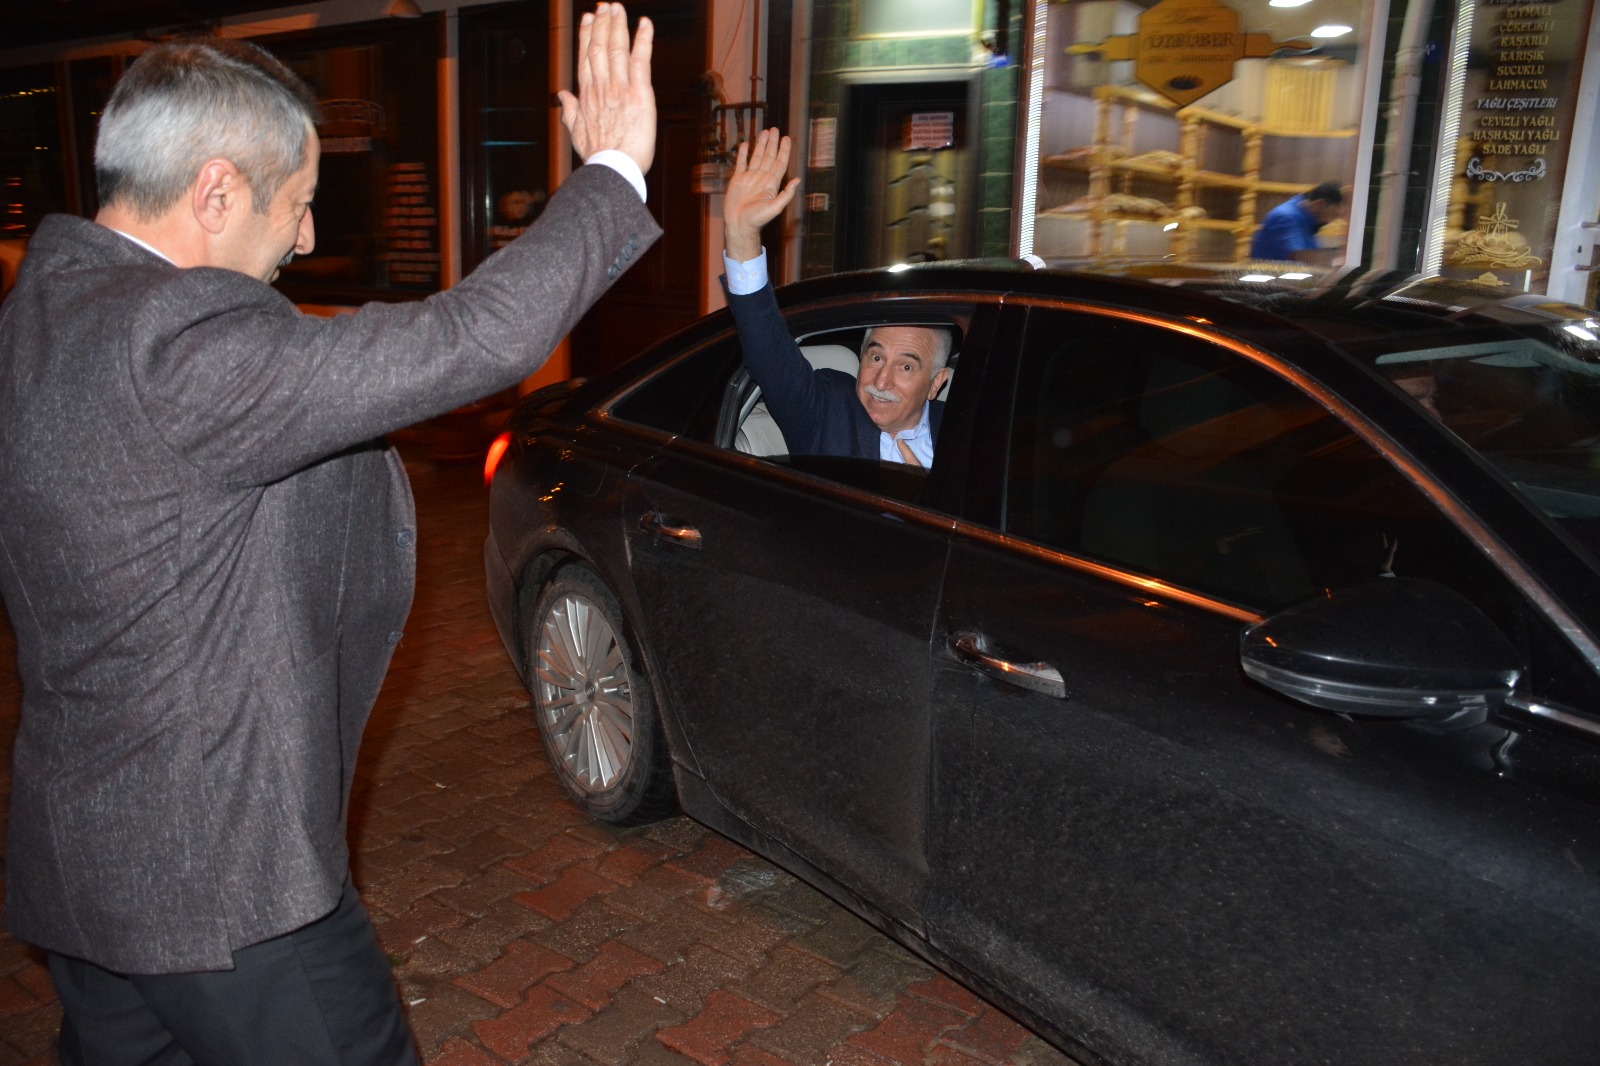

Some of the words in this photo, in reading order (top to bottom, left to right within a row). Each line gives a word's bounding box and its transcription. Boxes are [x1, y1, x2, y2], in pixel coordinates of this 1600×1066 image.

[1507, 6, 1552, 18] KIYMALI
[1501, 35, 1548, 49] KAŞARLI
[1500, 50, 1545, 62] KARIŞIK
[1497, 65, 1544, 76] SUCUKLU
[1489, 80, 1548, 90] LAHMACUN
[1477, 97, 1506, 109] YAĞLI
[1522, 115, 1555, 127] YAĞLI
[1473, 130, 1525, 143] HAŞHAŞLI
[1527, 129, 1560, 141] YAĞLI
[1482, 145, 1511, 155] SADE
[1513, 143, 1546, 155] YAĞLI
